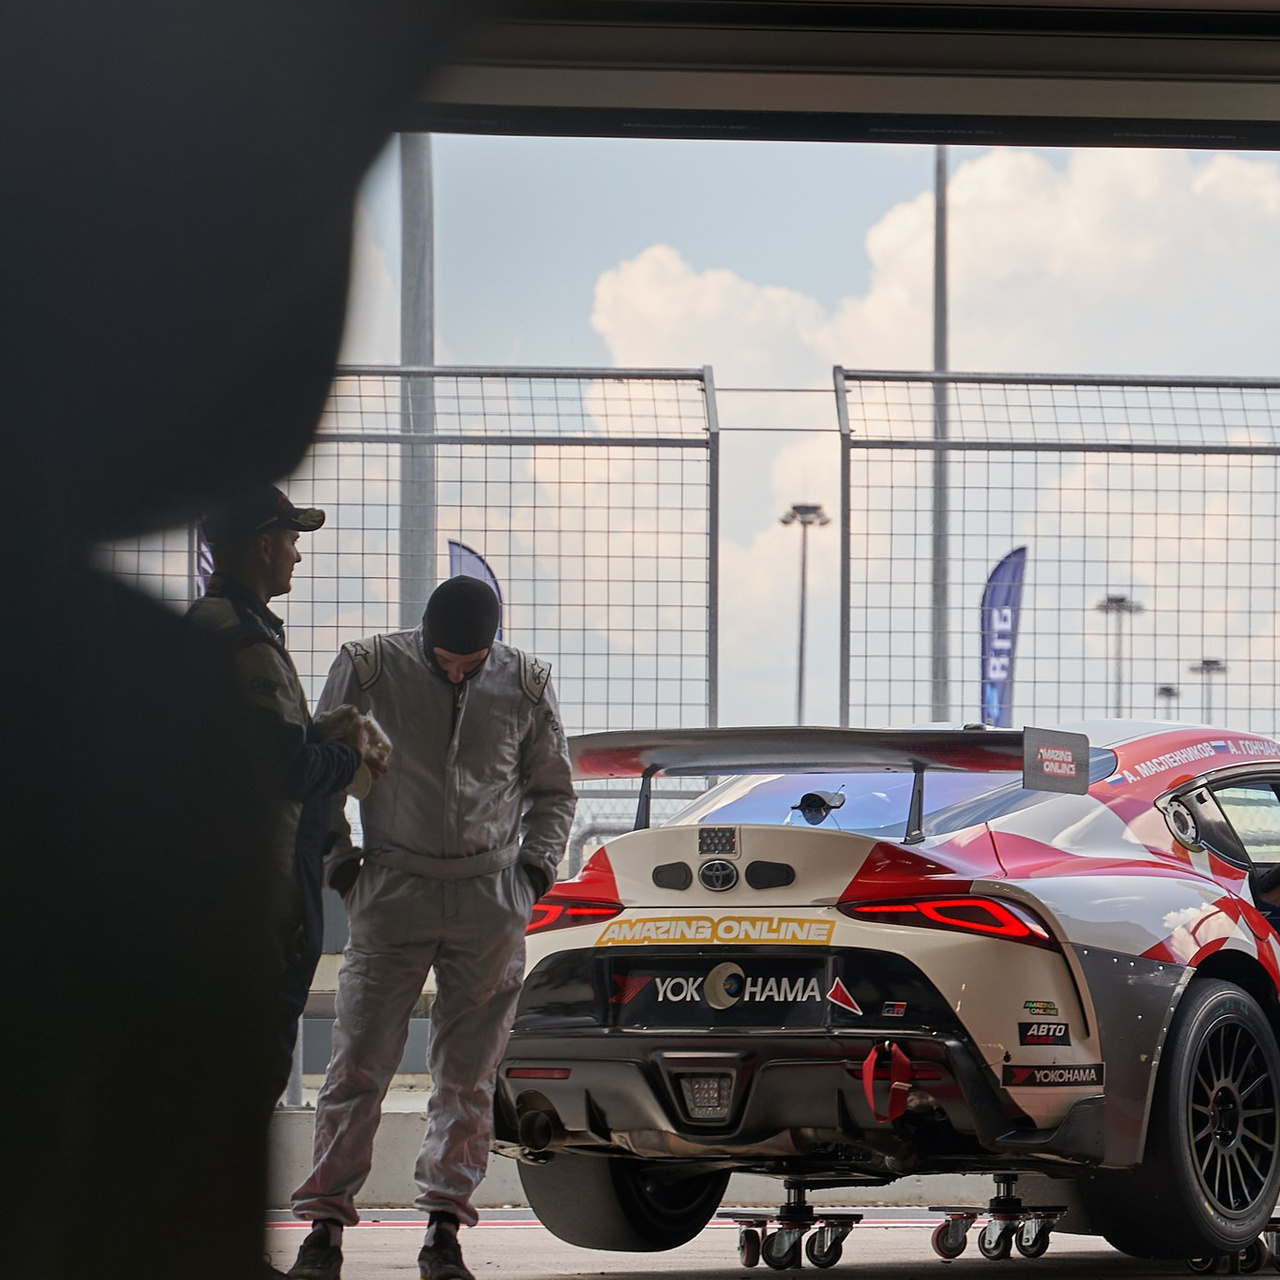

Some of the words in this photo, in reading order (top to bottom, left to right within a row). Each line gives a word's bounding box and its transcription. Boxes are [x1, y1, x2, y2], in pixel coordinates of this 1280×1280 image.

[1043, 761, 1076, 775] ONLINE
[1134, 741, 1217, 778] МАСЛЕННИКОВ
[602, 919, 713, 942] AMAZING
[716, 918, 831, 941] ONLINE
[655, 976, 822, 1003] YOKHAMA
[1027, 1024, 1066, 1036] АВТО
[1034, 1068, 1098, 1083] YOKOHAMA
